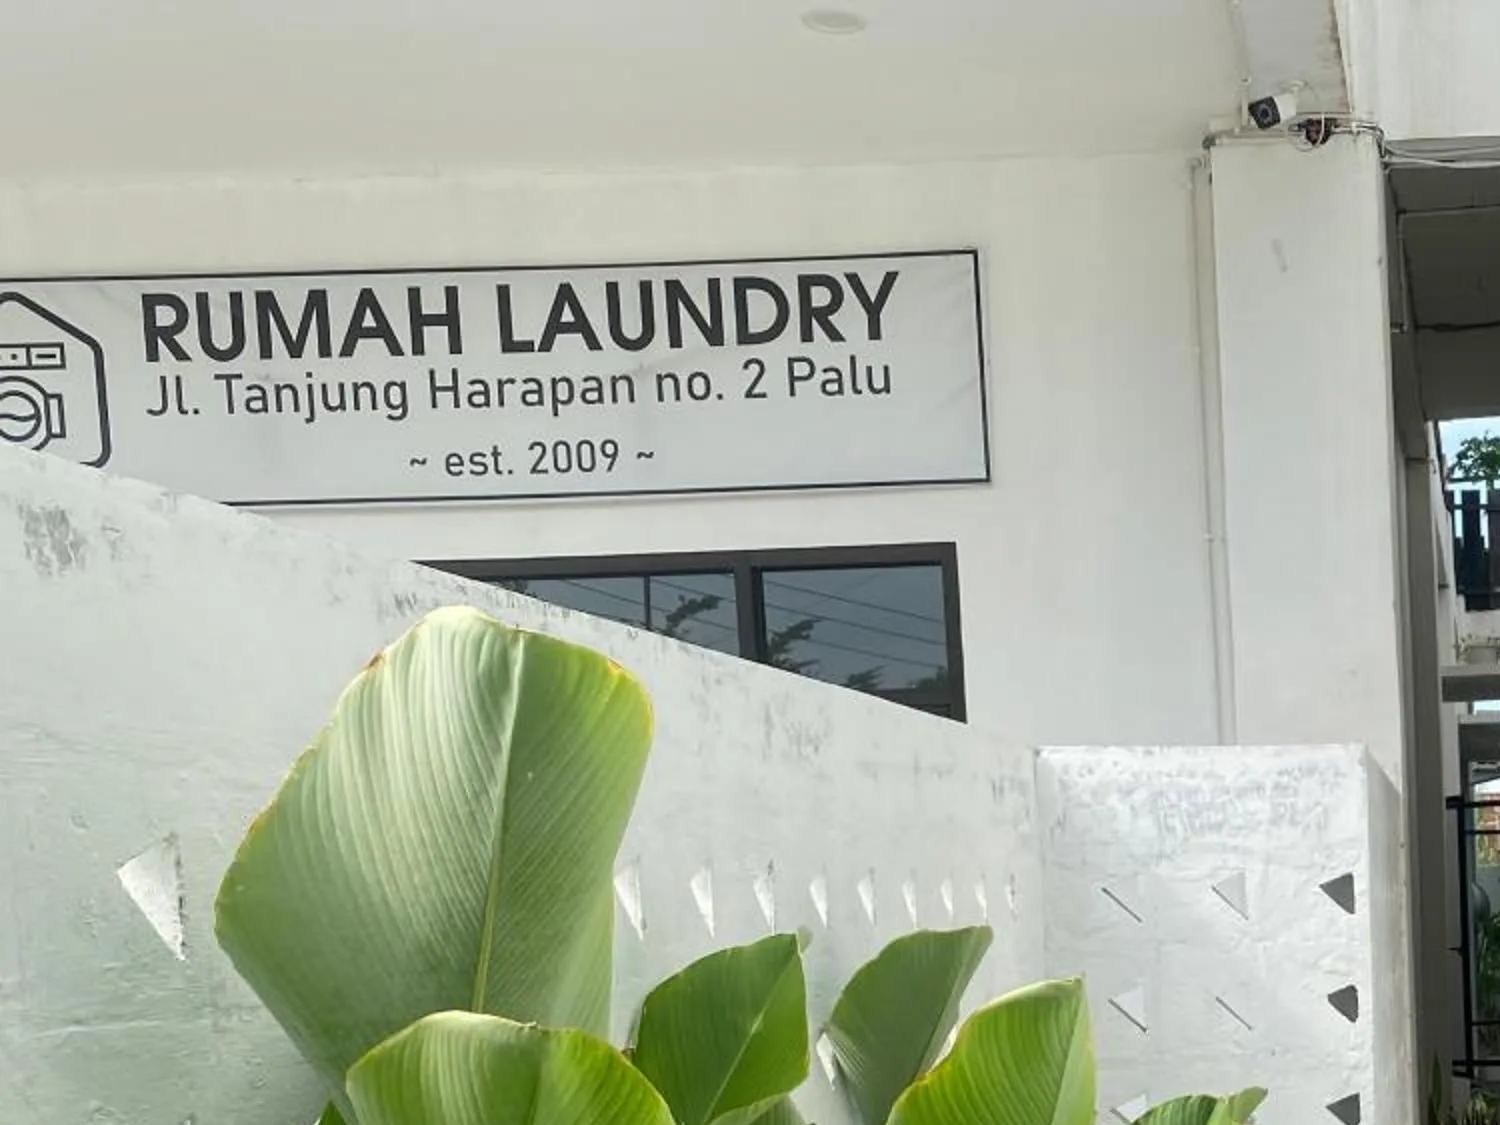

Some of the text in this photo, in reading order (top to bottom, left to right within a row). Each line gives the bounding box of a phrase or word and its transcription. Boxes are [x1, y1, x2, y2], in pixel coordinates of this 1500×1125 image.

[141, 270, 900, 363] RUMAH LAUNDRY
[146, 354, 891, 425] Jl. Tanjung Harapan no. 2 Palu
[445, 439, 619, 477] est. 2009
